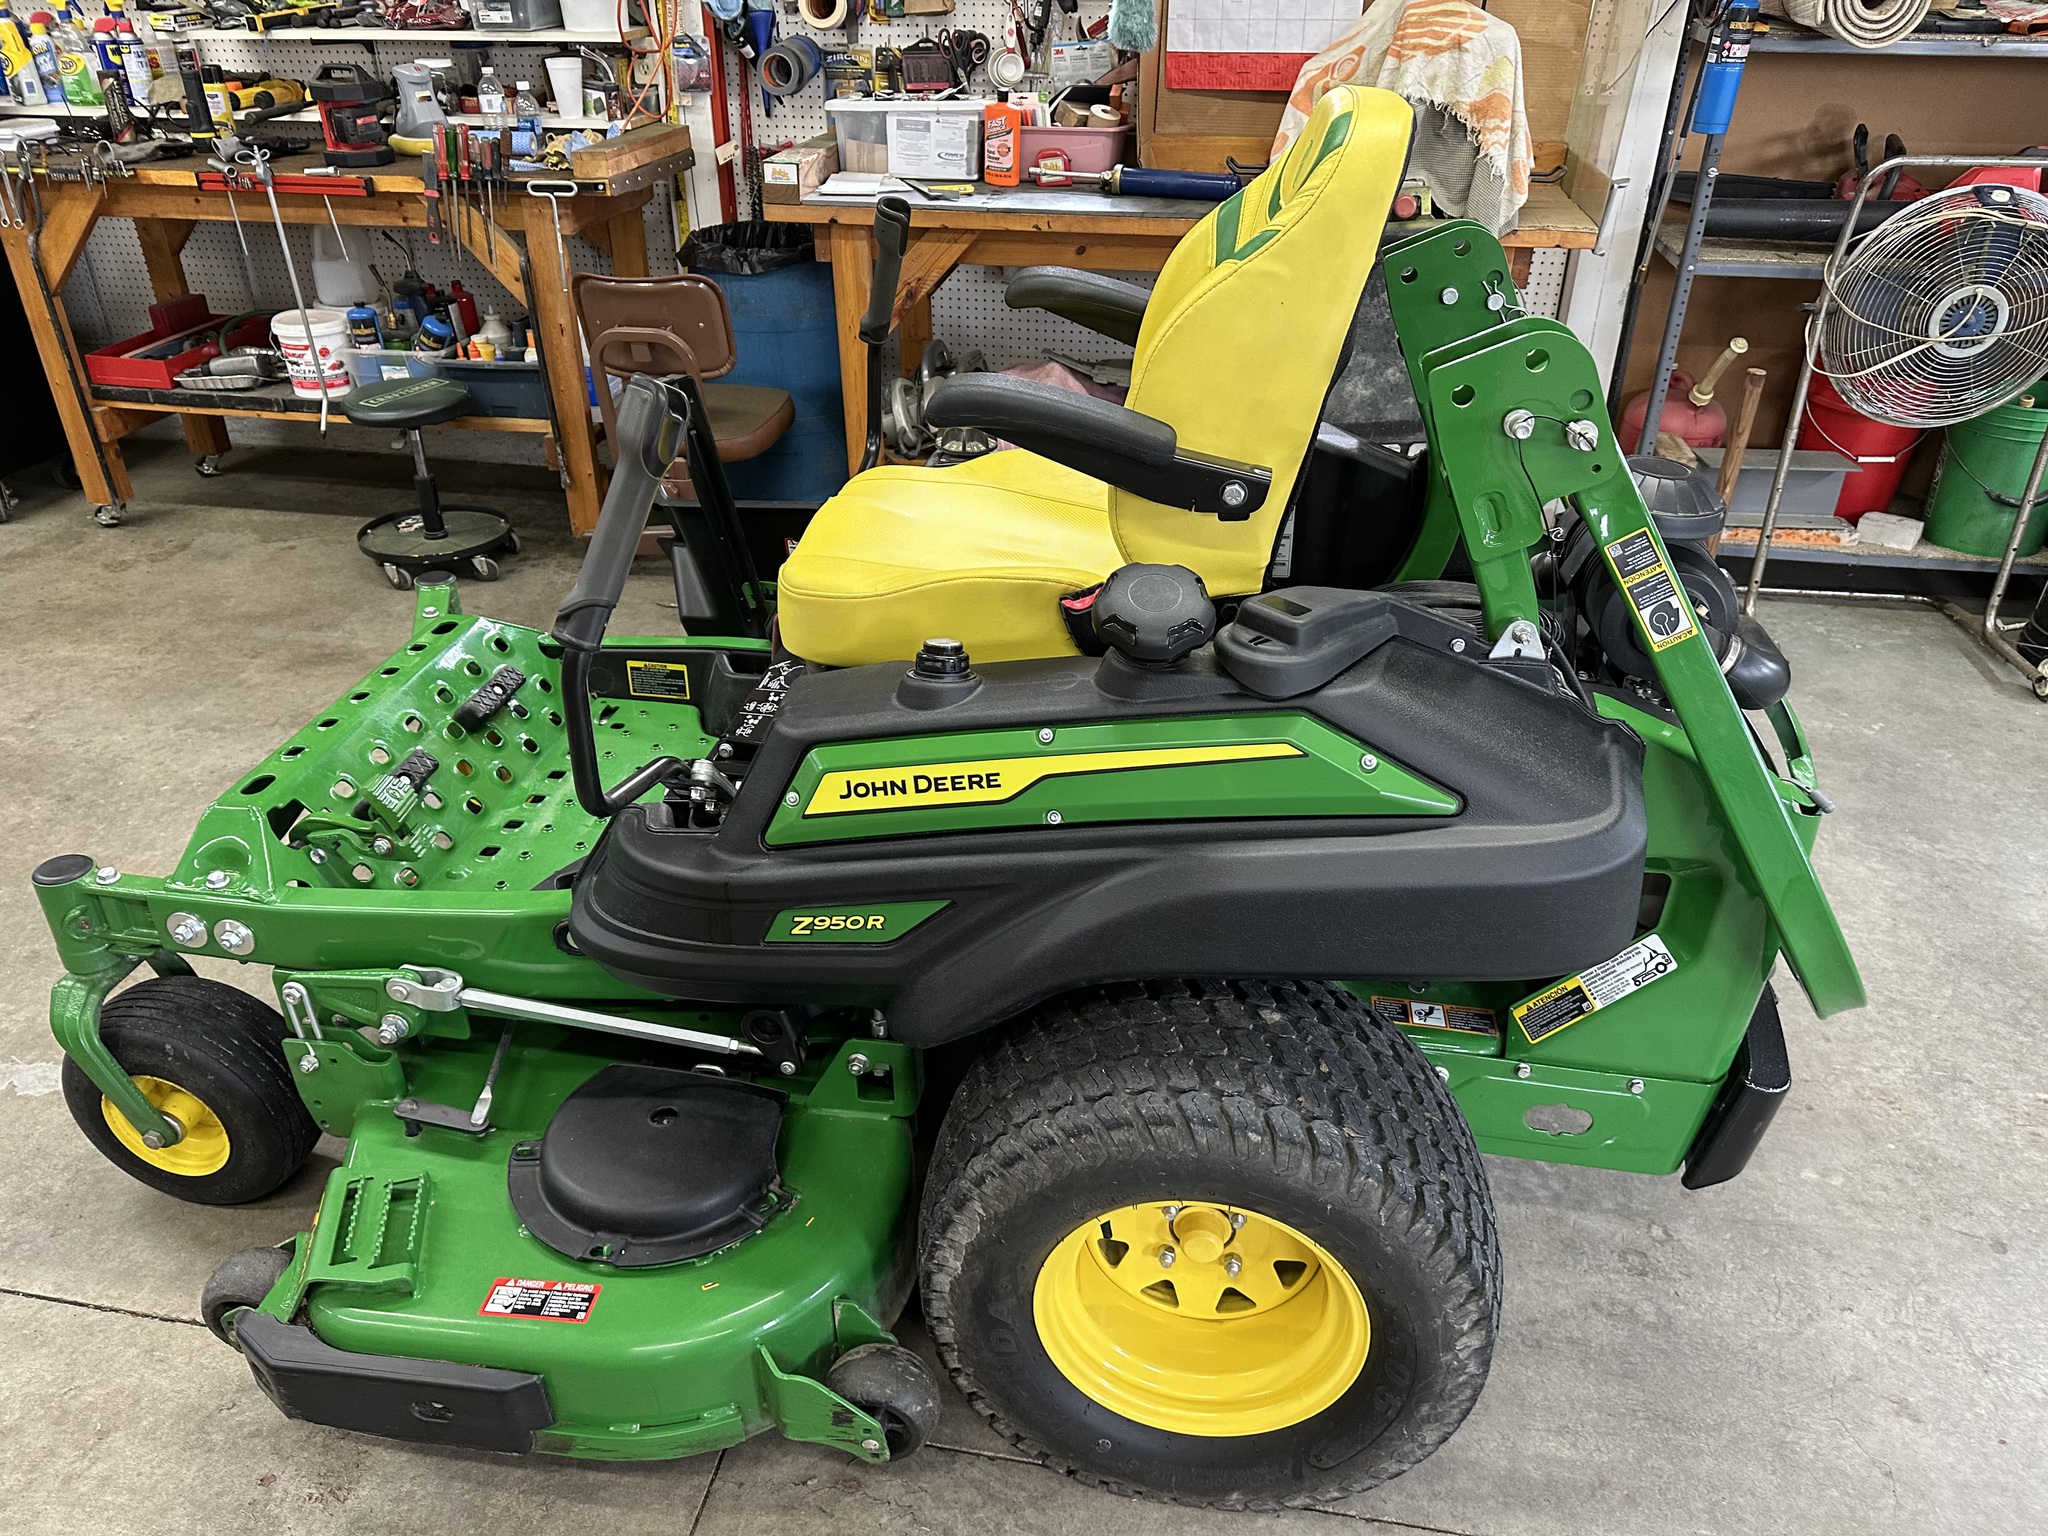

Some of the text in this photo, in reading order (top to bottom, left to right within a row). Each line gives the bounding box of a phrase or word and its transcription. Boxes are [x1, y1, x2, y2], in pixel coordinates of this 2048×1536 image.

[826, 53, 868, 64] ZIRCON
[988, 116, 1007, 126] FAST
[369, 380, 440, 404] CRAFTSMAN
[1623, 565, 1657, 586] ATENCIÓN
[1657, 632, 1688, 649] CAUTION
[840, 772, 1002, 799] JOHN DEERE
[790, 915, 885, 936] Z950R
[1532, 985, 1569, 1008] ATENCIÓN
[516, 1280, 546, 1288] DANGER
[564, 1284, 594, 1292] PELIGRO
